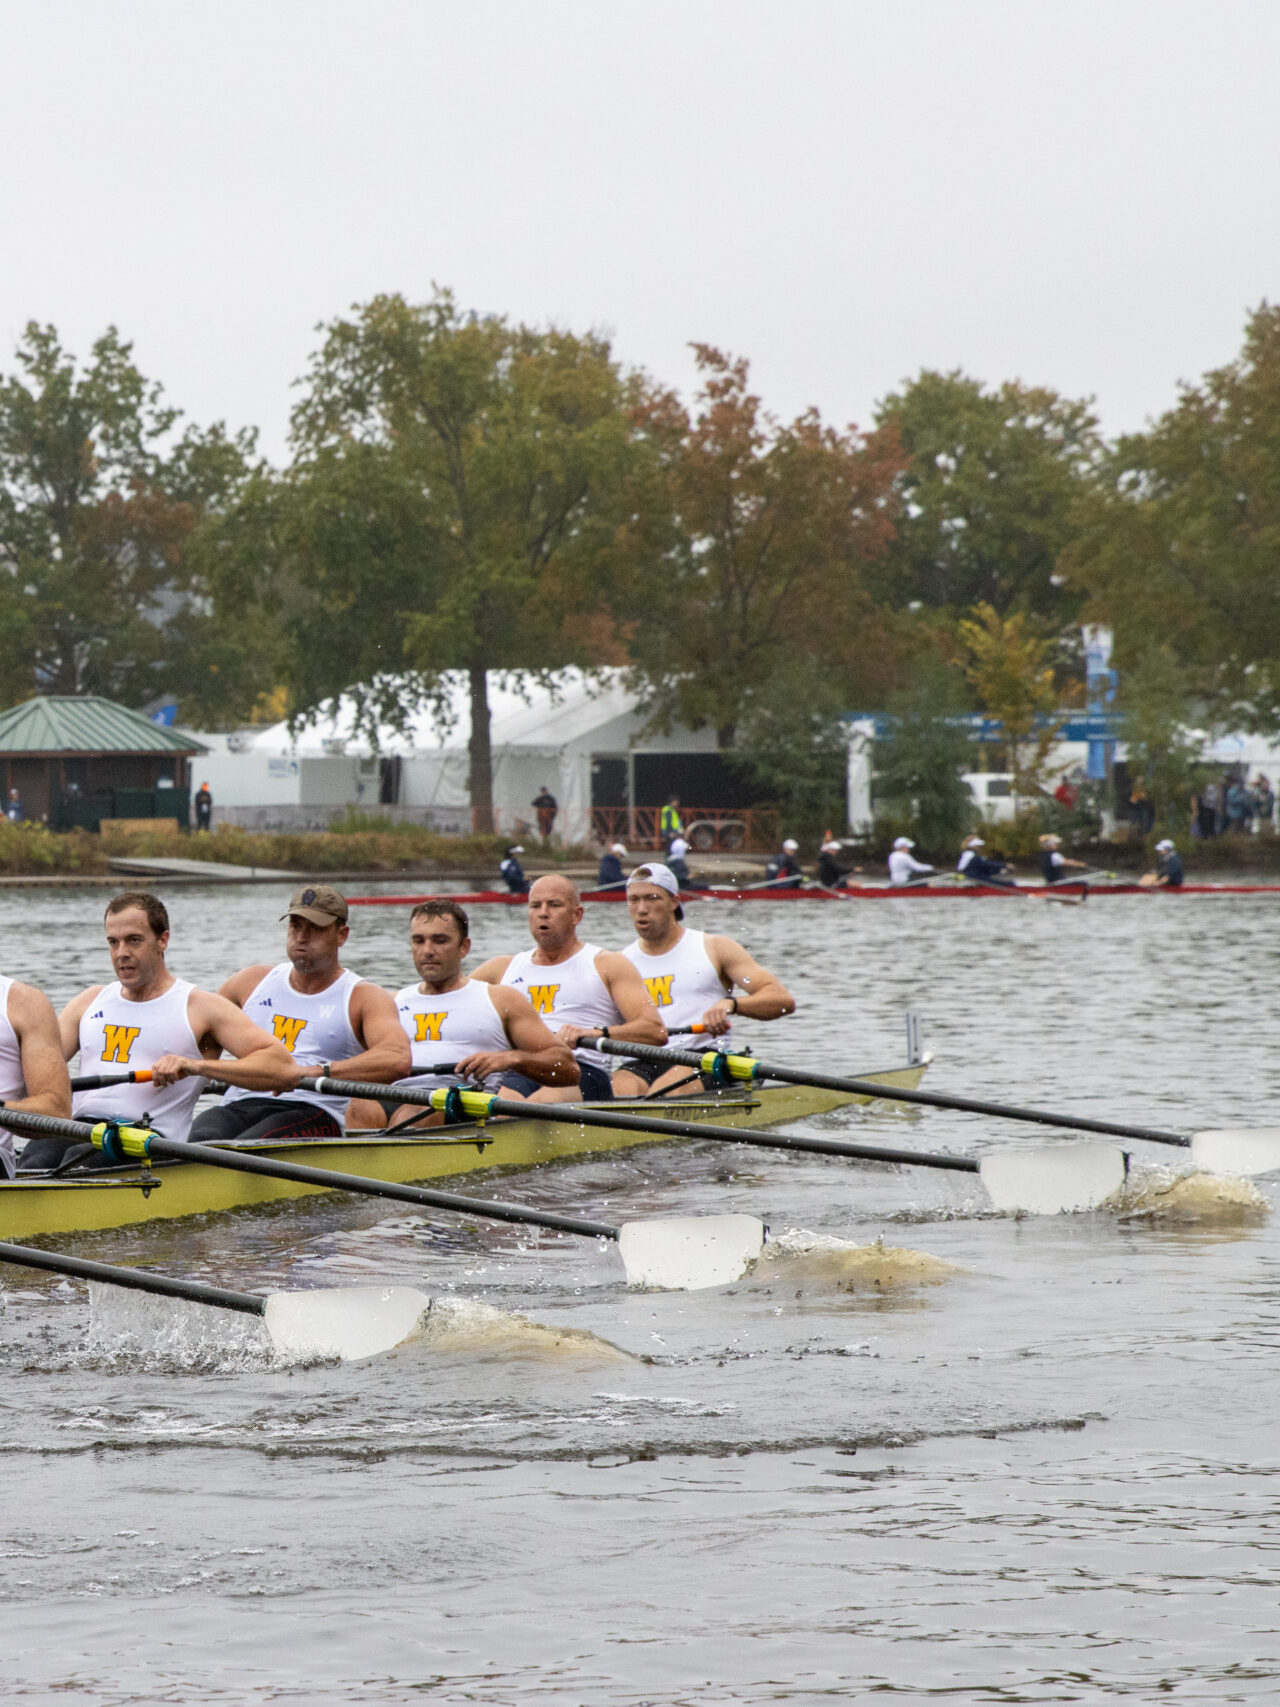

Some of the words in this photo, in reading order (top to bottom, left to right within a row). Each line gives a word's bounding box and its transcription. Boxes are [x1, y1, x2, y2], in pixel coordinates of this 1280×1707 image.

[528, 984, 560, 1014] W
[643, 974, 675, 1007] W
[272, 1014, 307, 1053] W
[413, 1012, 448, 1042] W
[101, 1024, 141, 1064] W
